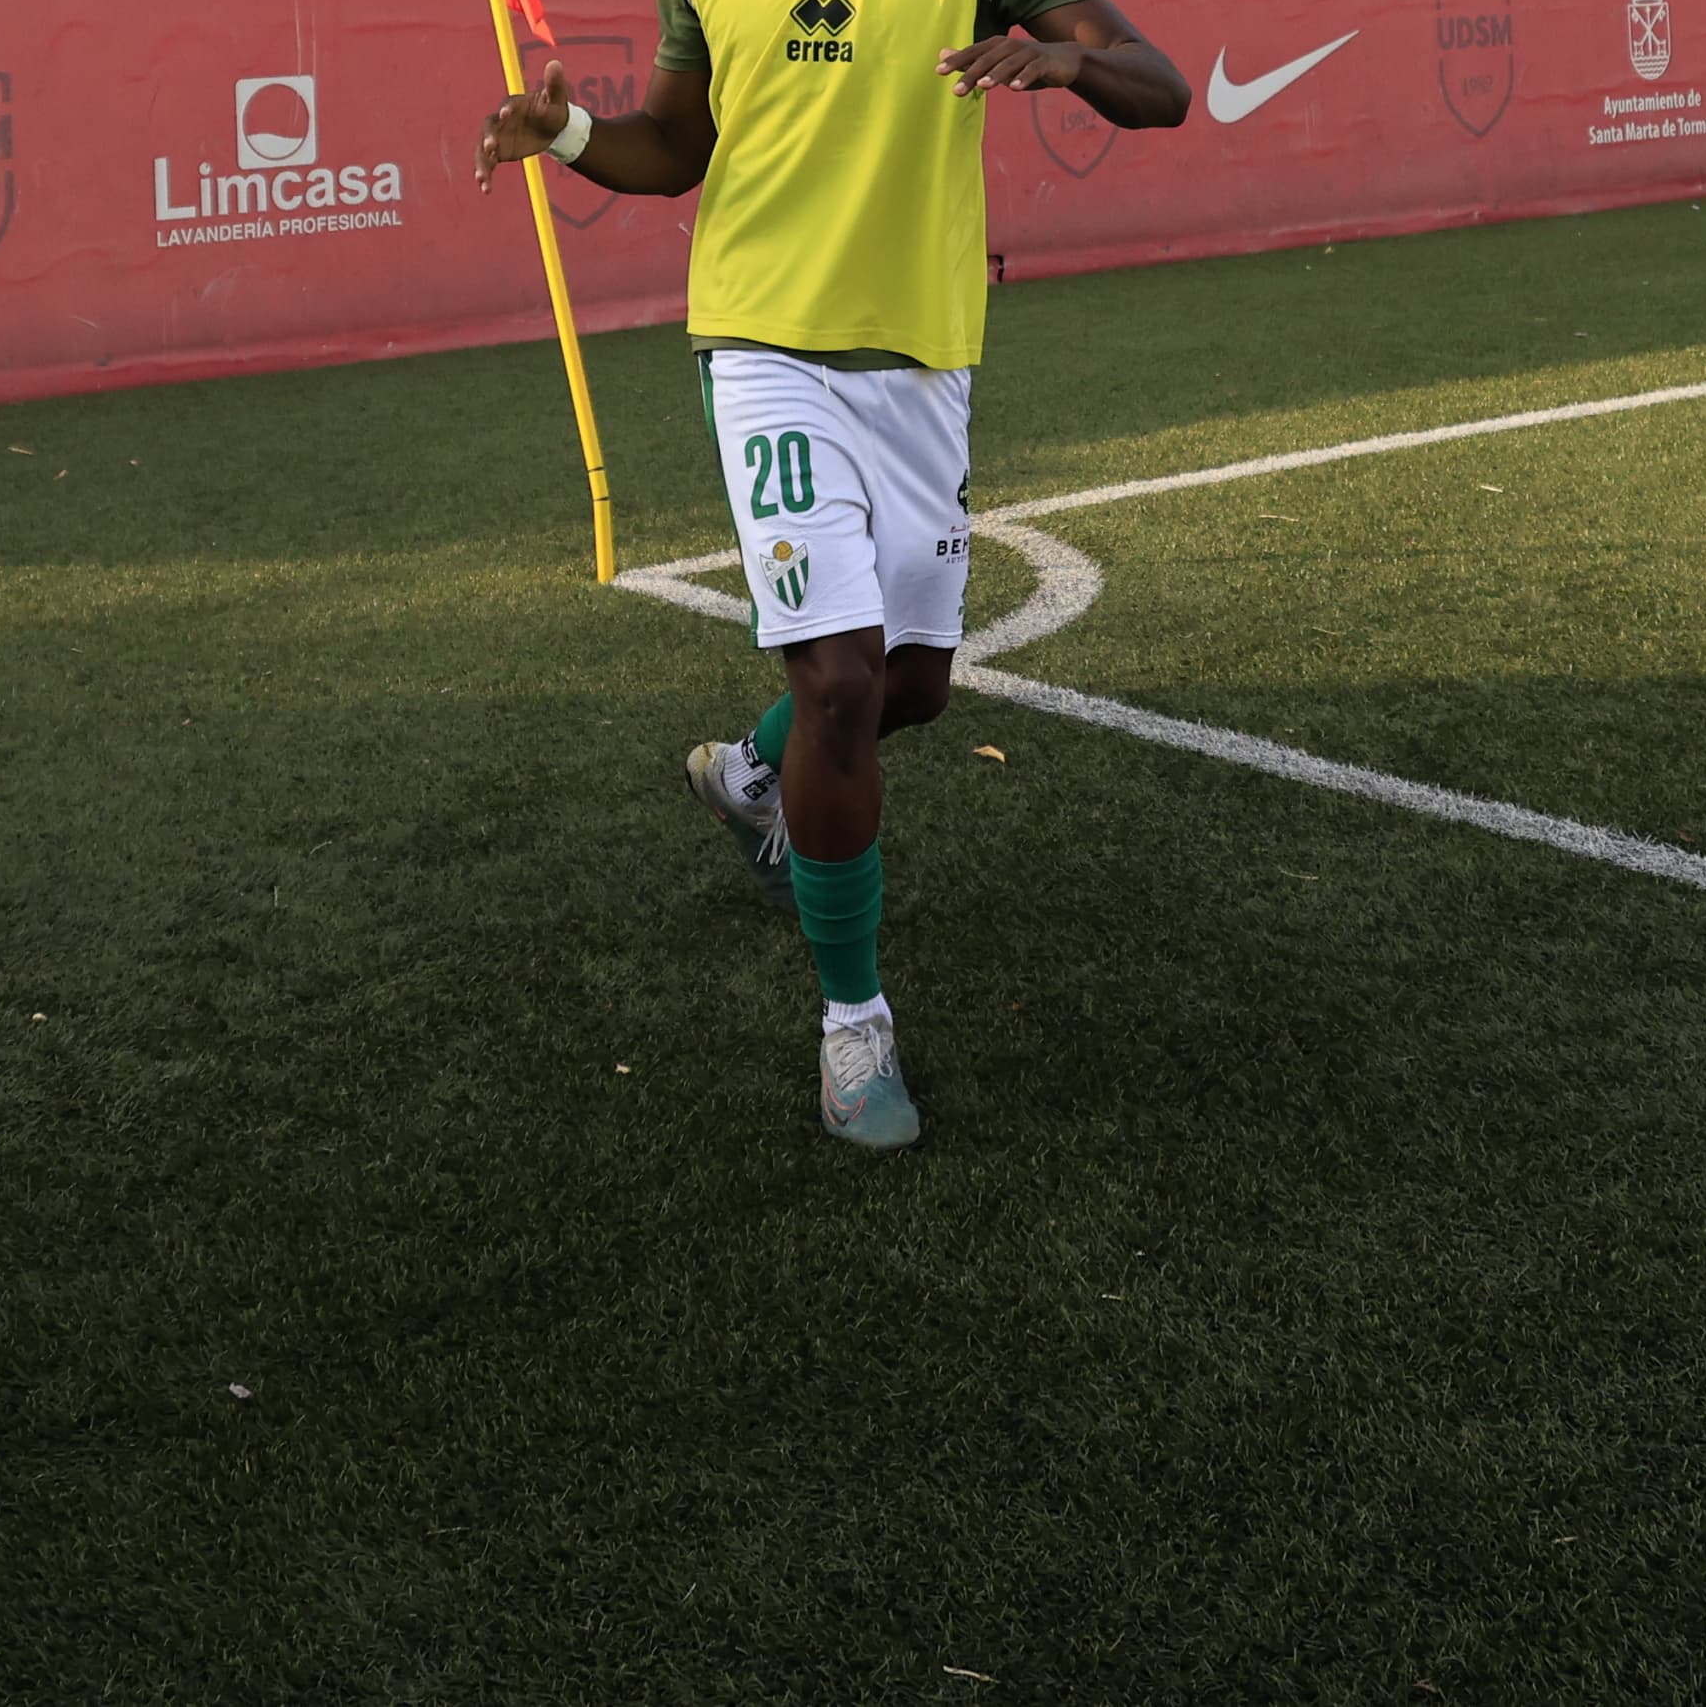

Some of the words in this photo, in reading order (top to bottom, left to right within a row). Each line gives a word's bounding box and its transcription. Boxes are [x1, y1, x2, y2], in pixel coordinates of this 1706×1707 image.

[1437, 14, 1513, 50] UDSM
[786, 38, 853, 63] errea
[1604, 92, 1685, 118] Ayuntamiento
[1688, 89, 1702, 107] de
[1589, 125, 1623, 145] Santa
[1625, 122, 1660, 141] Marta
[1662, 118, 1676, 138] de
[154, 158, 402, 220] Limcasa
[157, 217, 275, 247] LAVANDERÍA
[279, 210, 402, 236] PROFESIONAL
[744, 430, 815, 520] 20
